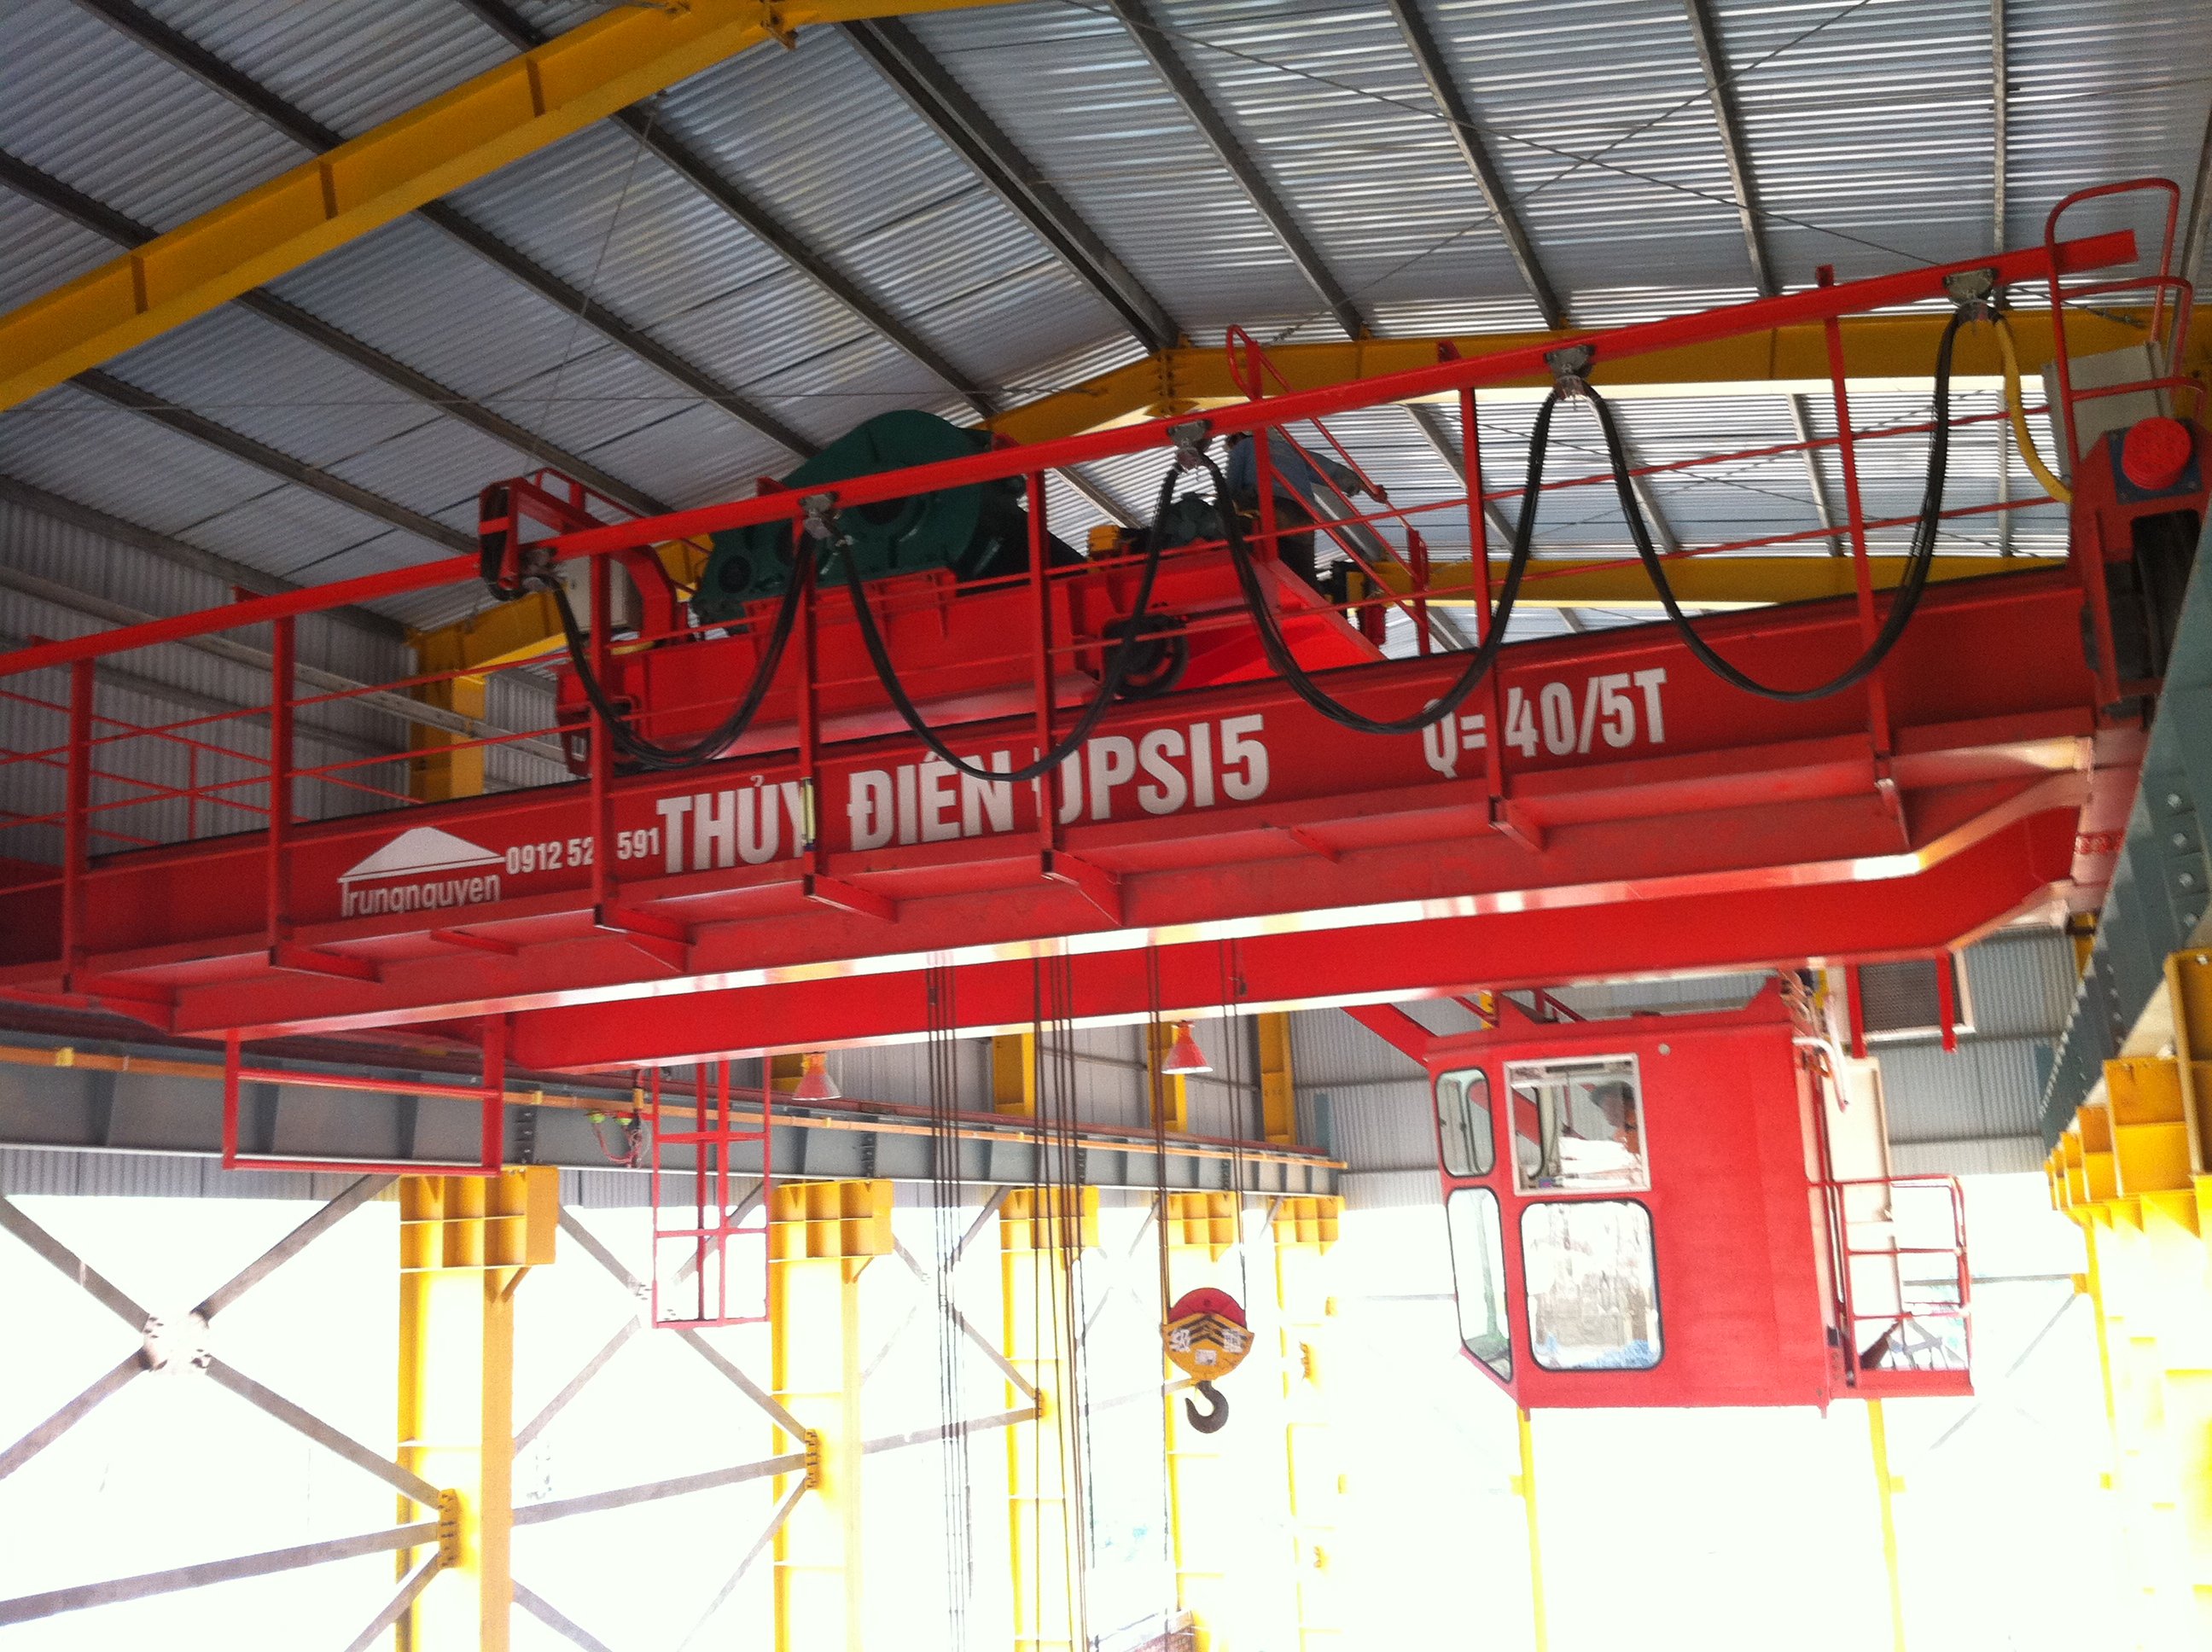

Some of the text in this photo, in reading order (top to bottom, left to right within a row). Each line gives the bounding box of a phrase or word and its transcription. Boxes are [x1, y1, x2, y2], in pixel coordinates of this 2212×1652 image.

[1504, 667, 1668, 758] 40/5T
[505, 827, 661, 875] 0912 52 591
